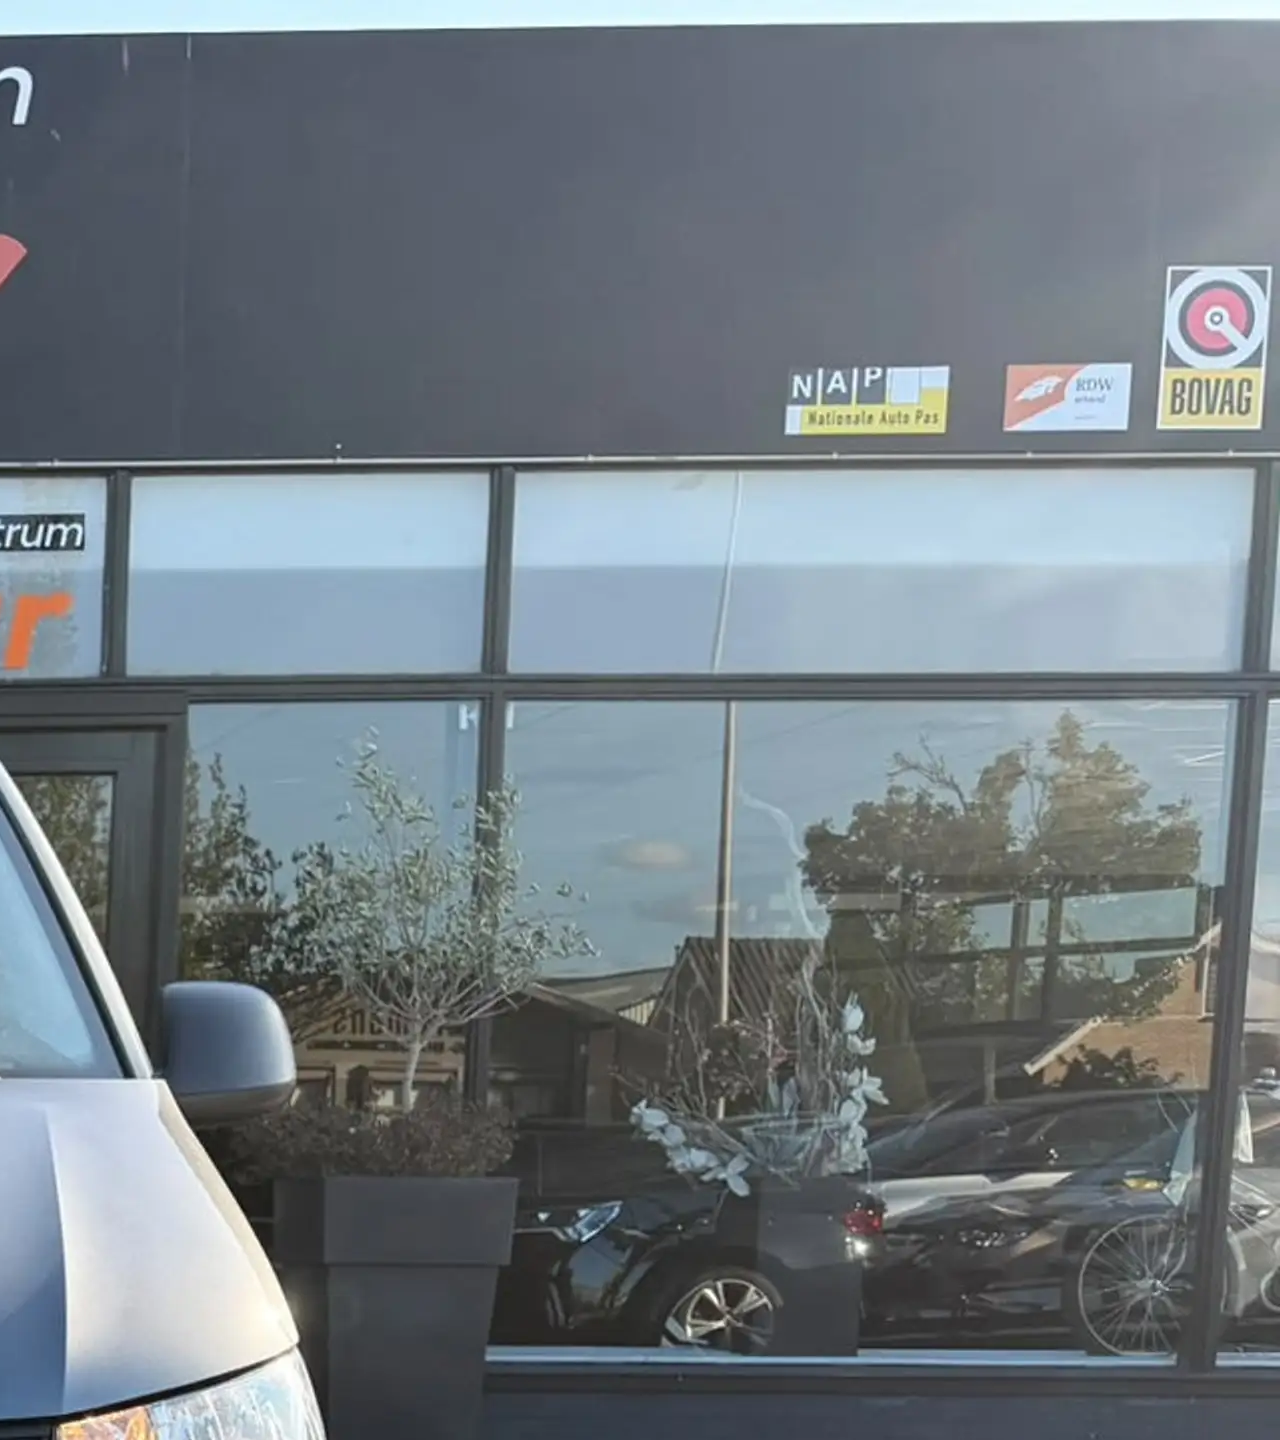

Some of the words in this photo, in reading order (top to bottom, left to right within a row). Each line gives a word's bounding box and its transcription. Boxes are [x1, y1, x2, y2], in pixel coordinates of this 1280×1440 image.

[792, 366, 883, 399] NAP
[1075, 376, 1115, 392] RDW
[1168, 377, 1252, 416] BOVAG
[808, 409, 873, 426] Nationale
[879, 408, 911, 425] Auto
[915, 407, 940, 425] Pas
